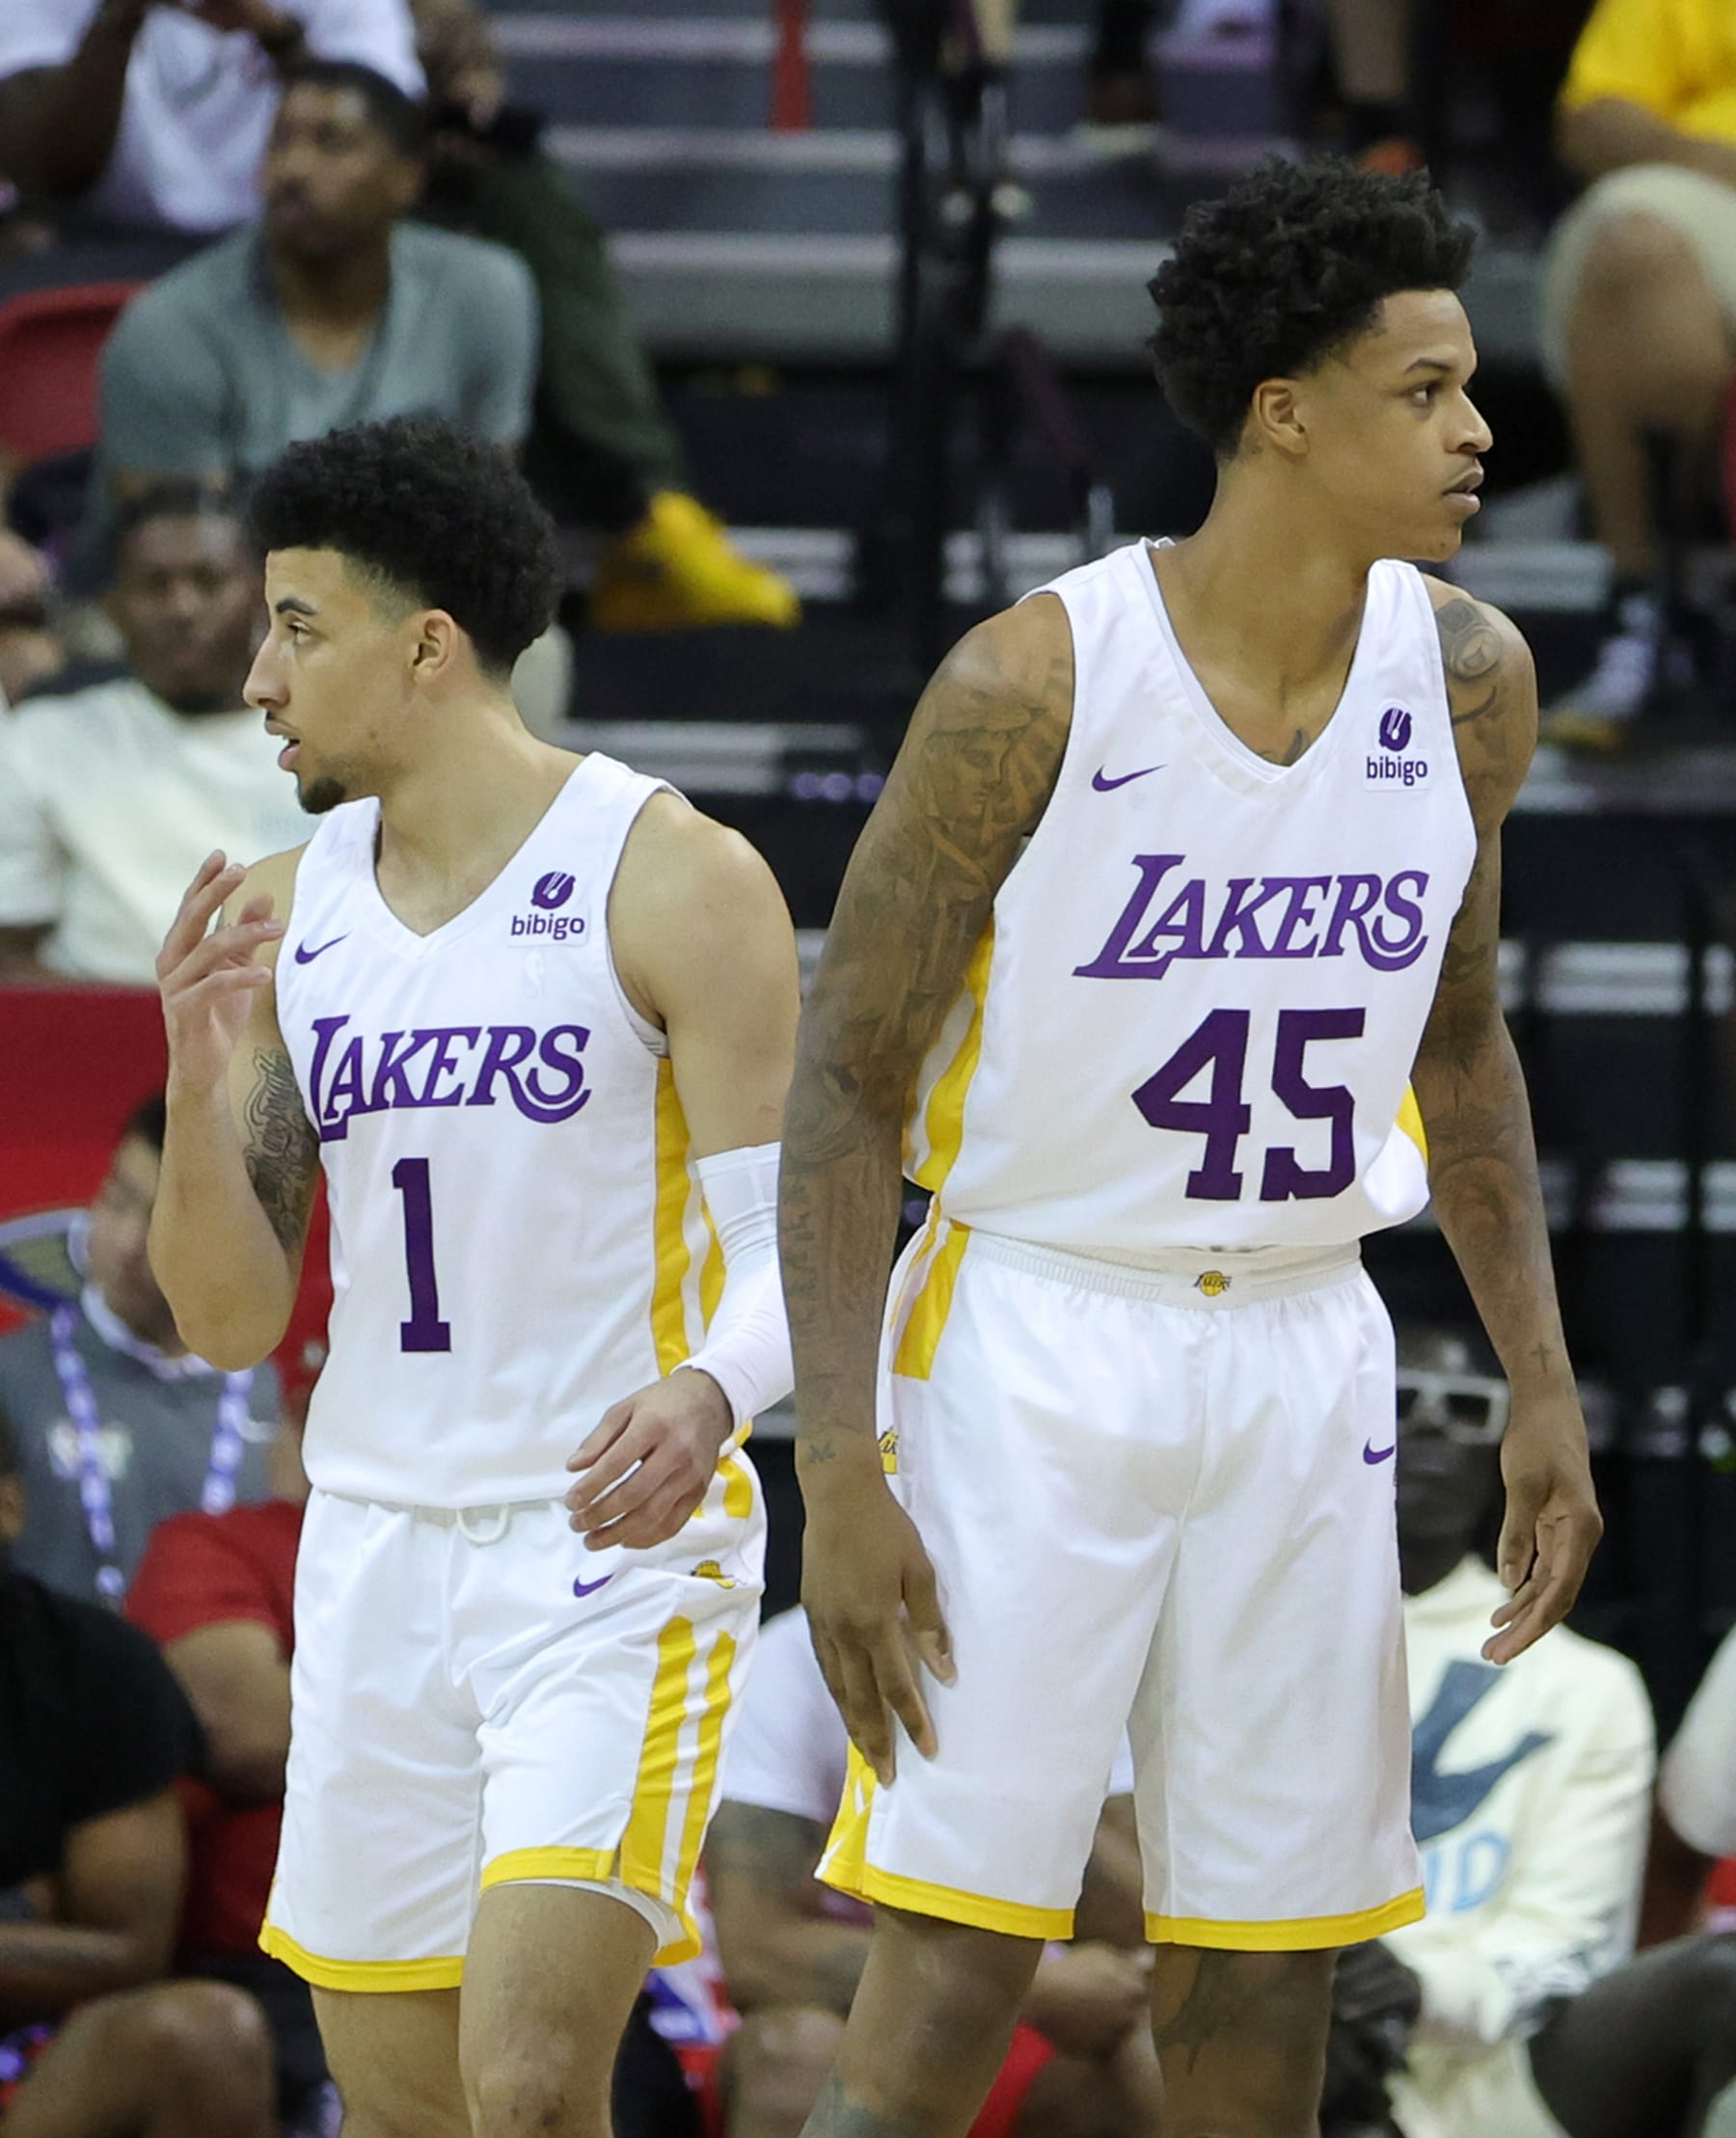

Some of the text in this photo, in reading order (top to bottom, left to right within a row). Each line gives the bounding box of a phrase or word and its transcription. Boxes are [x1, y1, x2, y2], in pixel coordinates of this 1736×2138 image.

[1366, 755, 1428, 786] bibigo
[510, 912, 585, 940] bibigo
[1072, 854, 1430, 980] LAKERS
[310, 1015, 592, 1143] LAKERS
[1131, 1008, 1366, 1201] 45
[392, 1157, 451, 1352] 1
